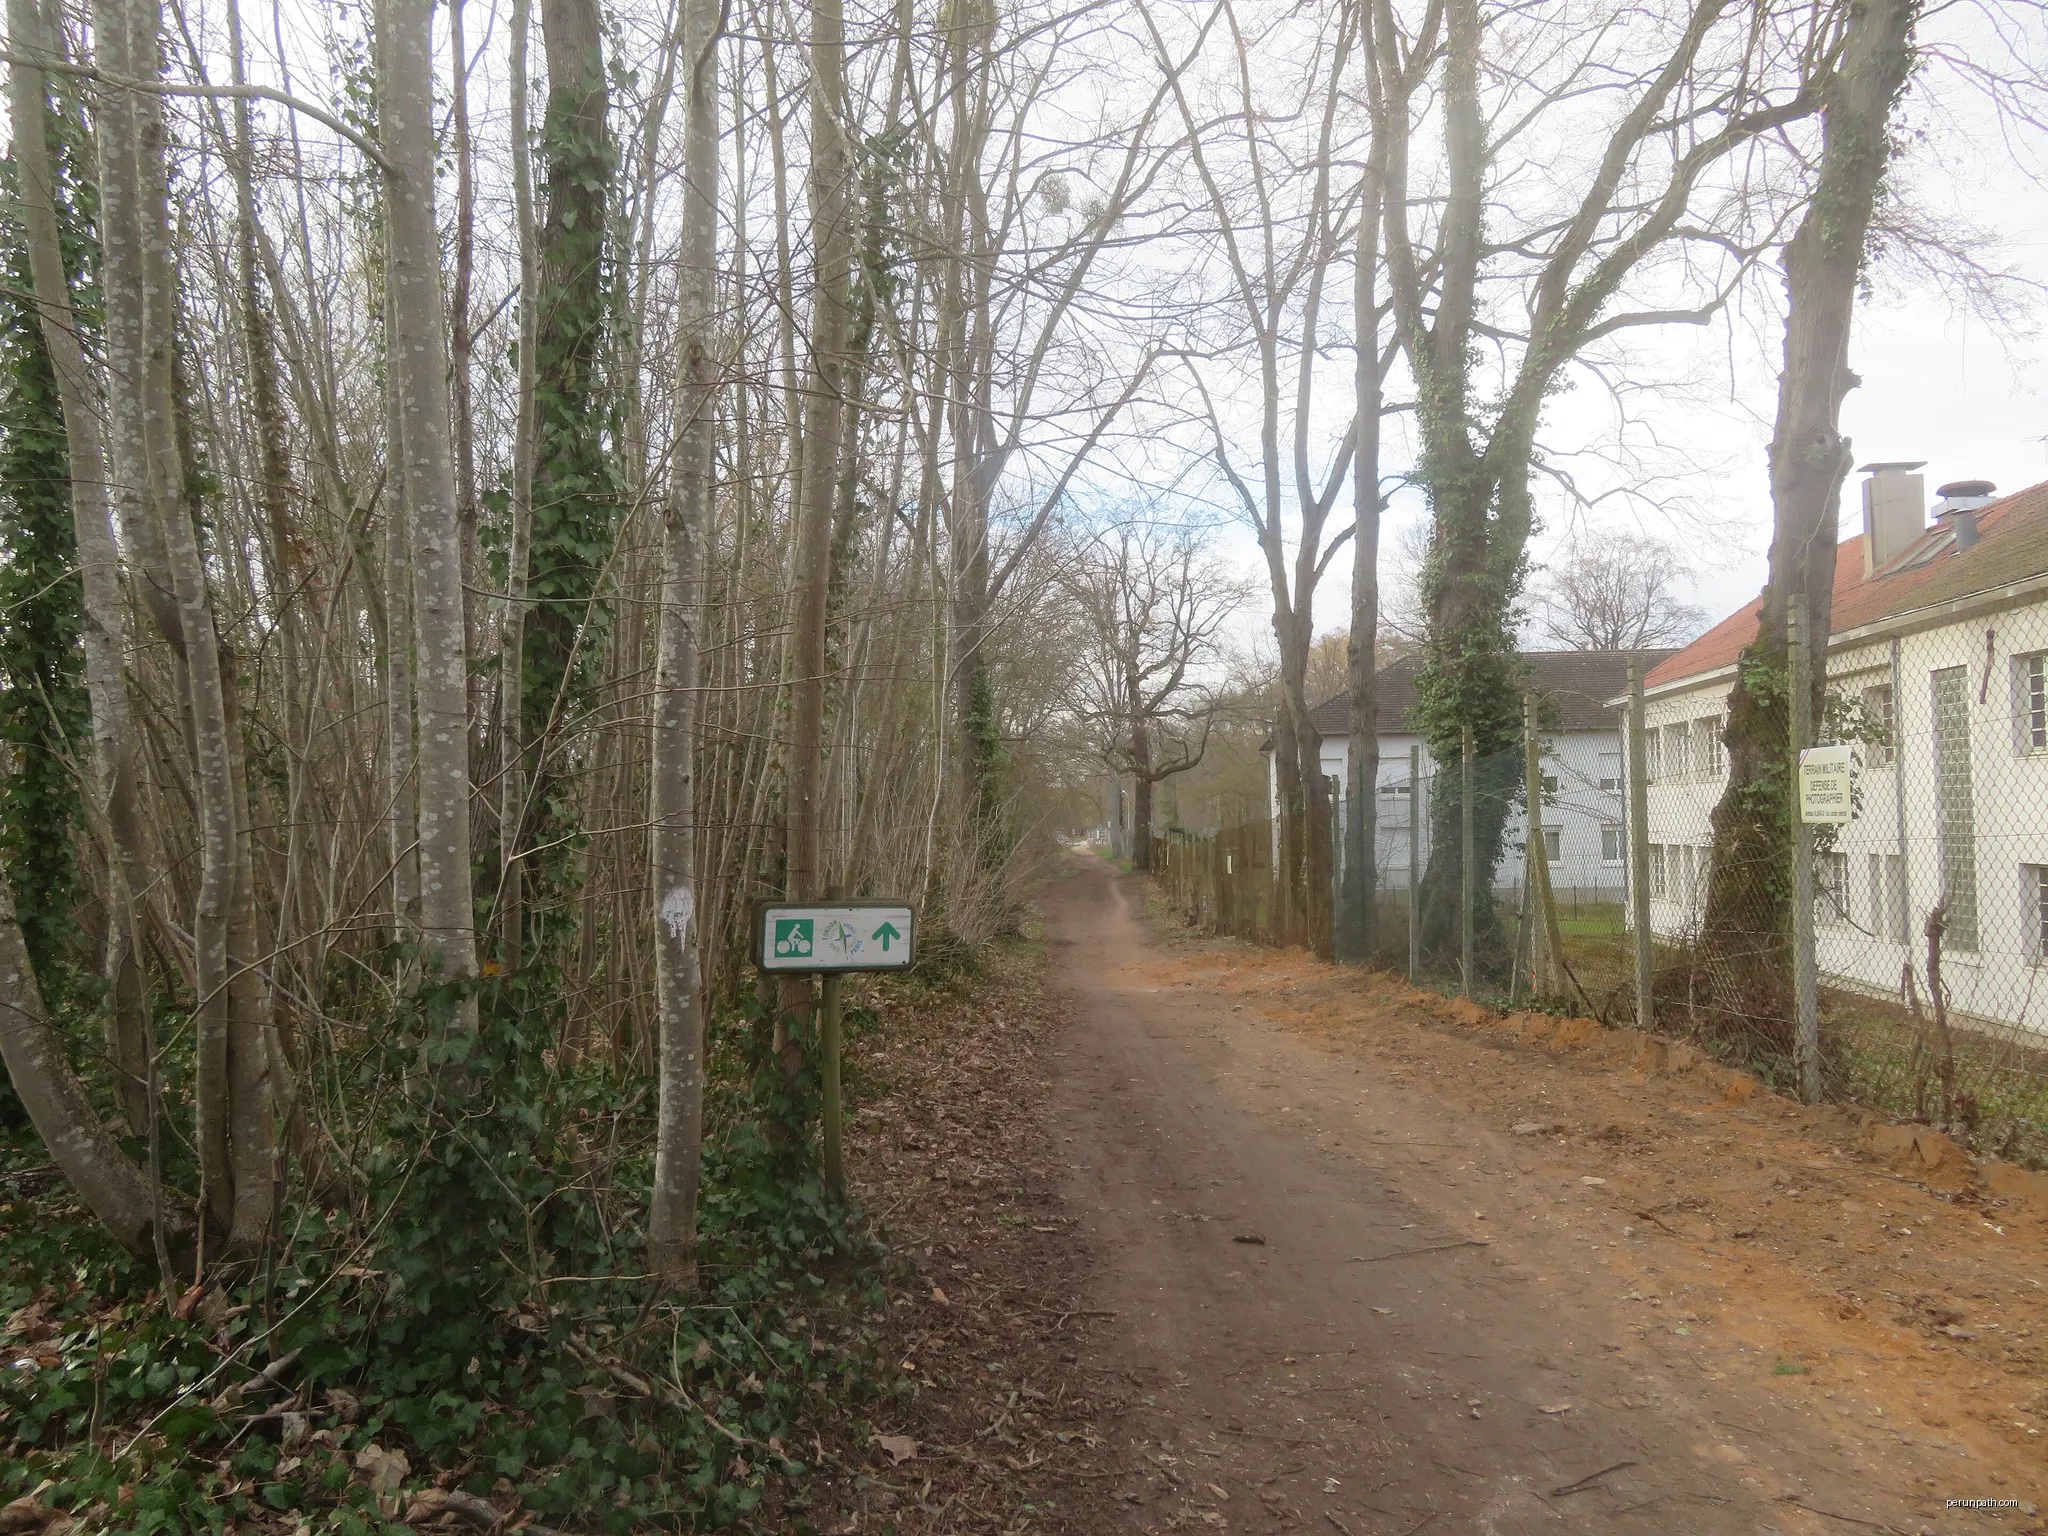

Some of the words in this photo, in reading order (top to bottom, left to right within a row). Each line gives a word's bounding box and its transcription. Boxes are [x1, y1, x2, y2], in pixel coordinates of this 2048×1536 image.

[1804, 764, 1821, 775] TERRAIN
[1822, 762, 1845, 774] MILITAIRE
[1810, 780, 1830, 791] DEFENSE
[1831, 780, 1837, 790] DE
[1806, 793, 1844, 804] PHOTOGRAPHIER
[822, 919, 838, 940] LONDON
[850, 939, 863, 955] PARIS
